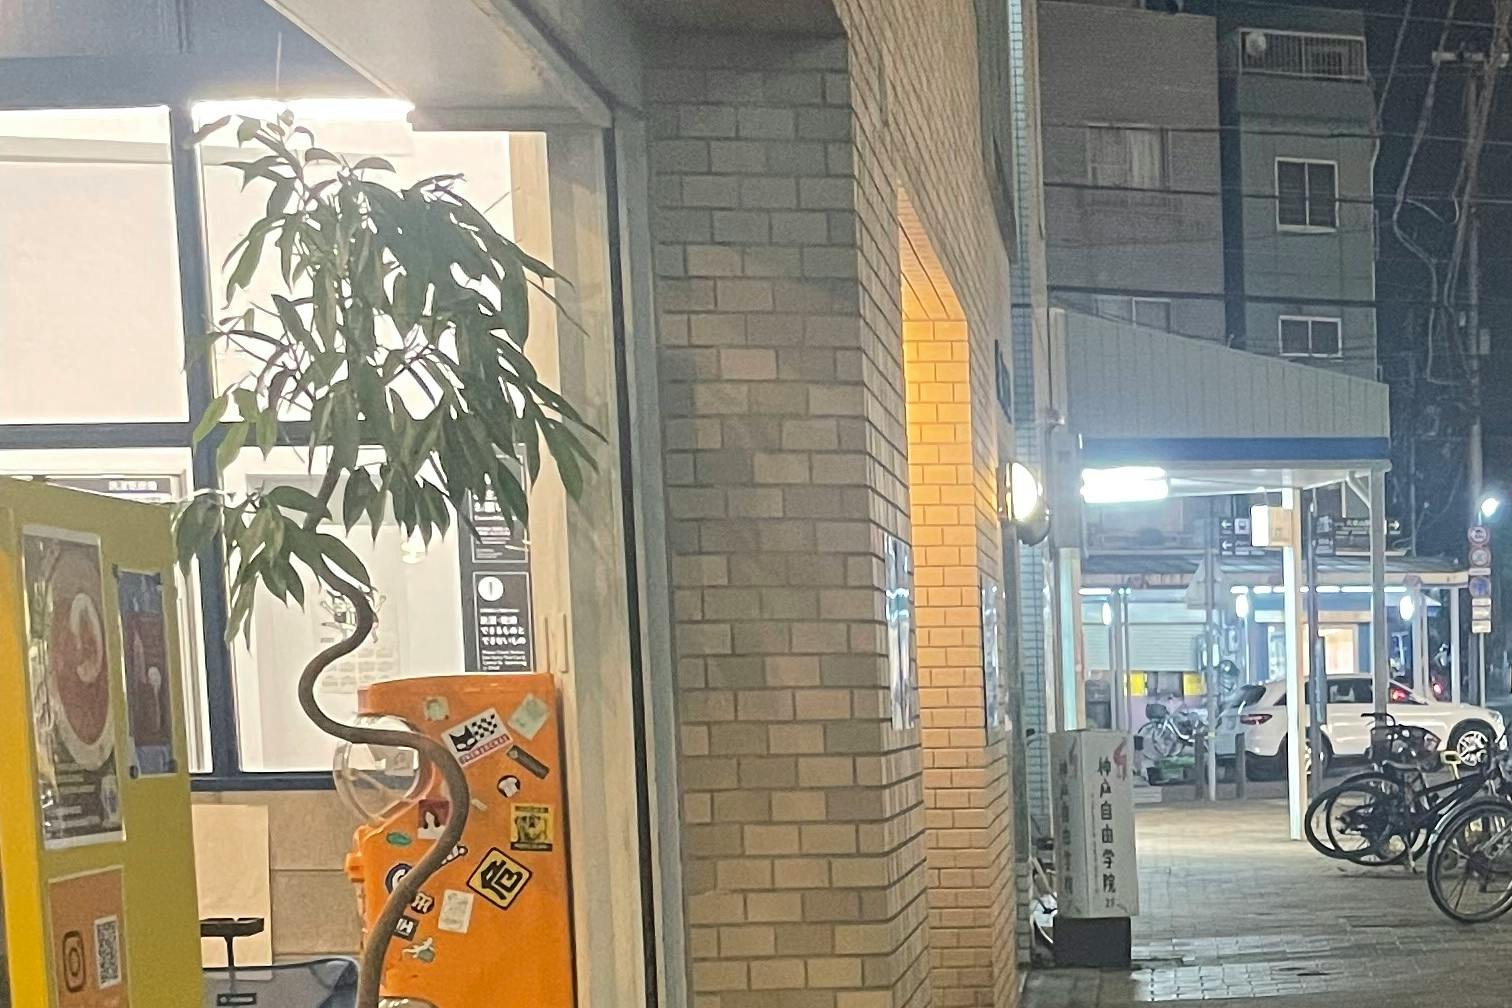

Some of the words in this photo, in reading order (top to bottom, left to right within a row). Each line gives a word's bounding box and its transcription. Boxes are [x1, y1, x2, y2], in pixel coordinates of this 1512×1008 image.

[1098, 755, 1116, 894] 神戸自由学院
[480, 859, 523, 900] 危
